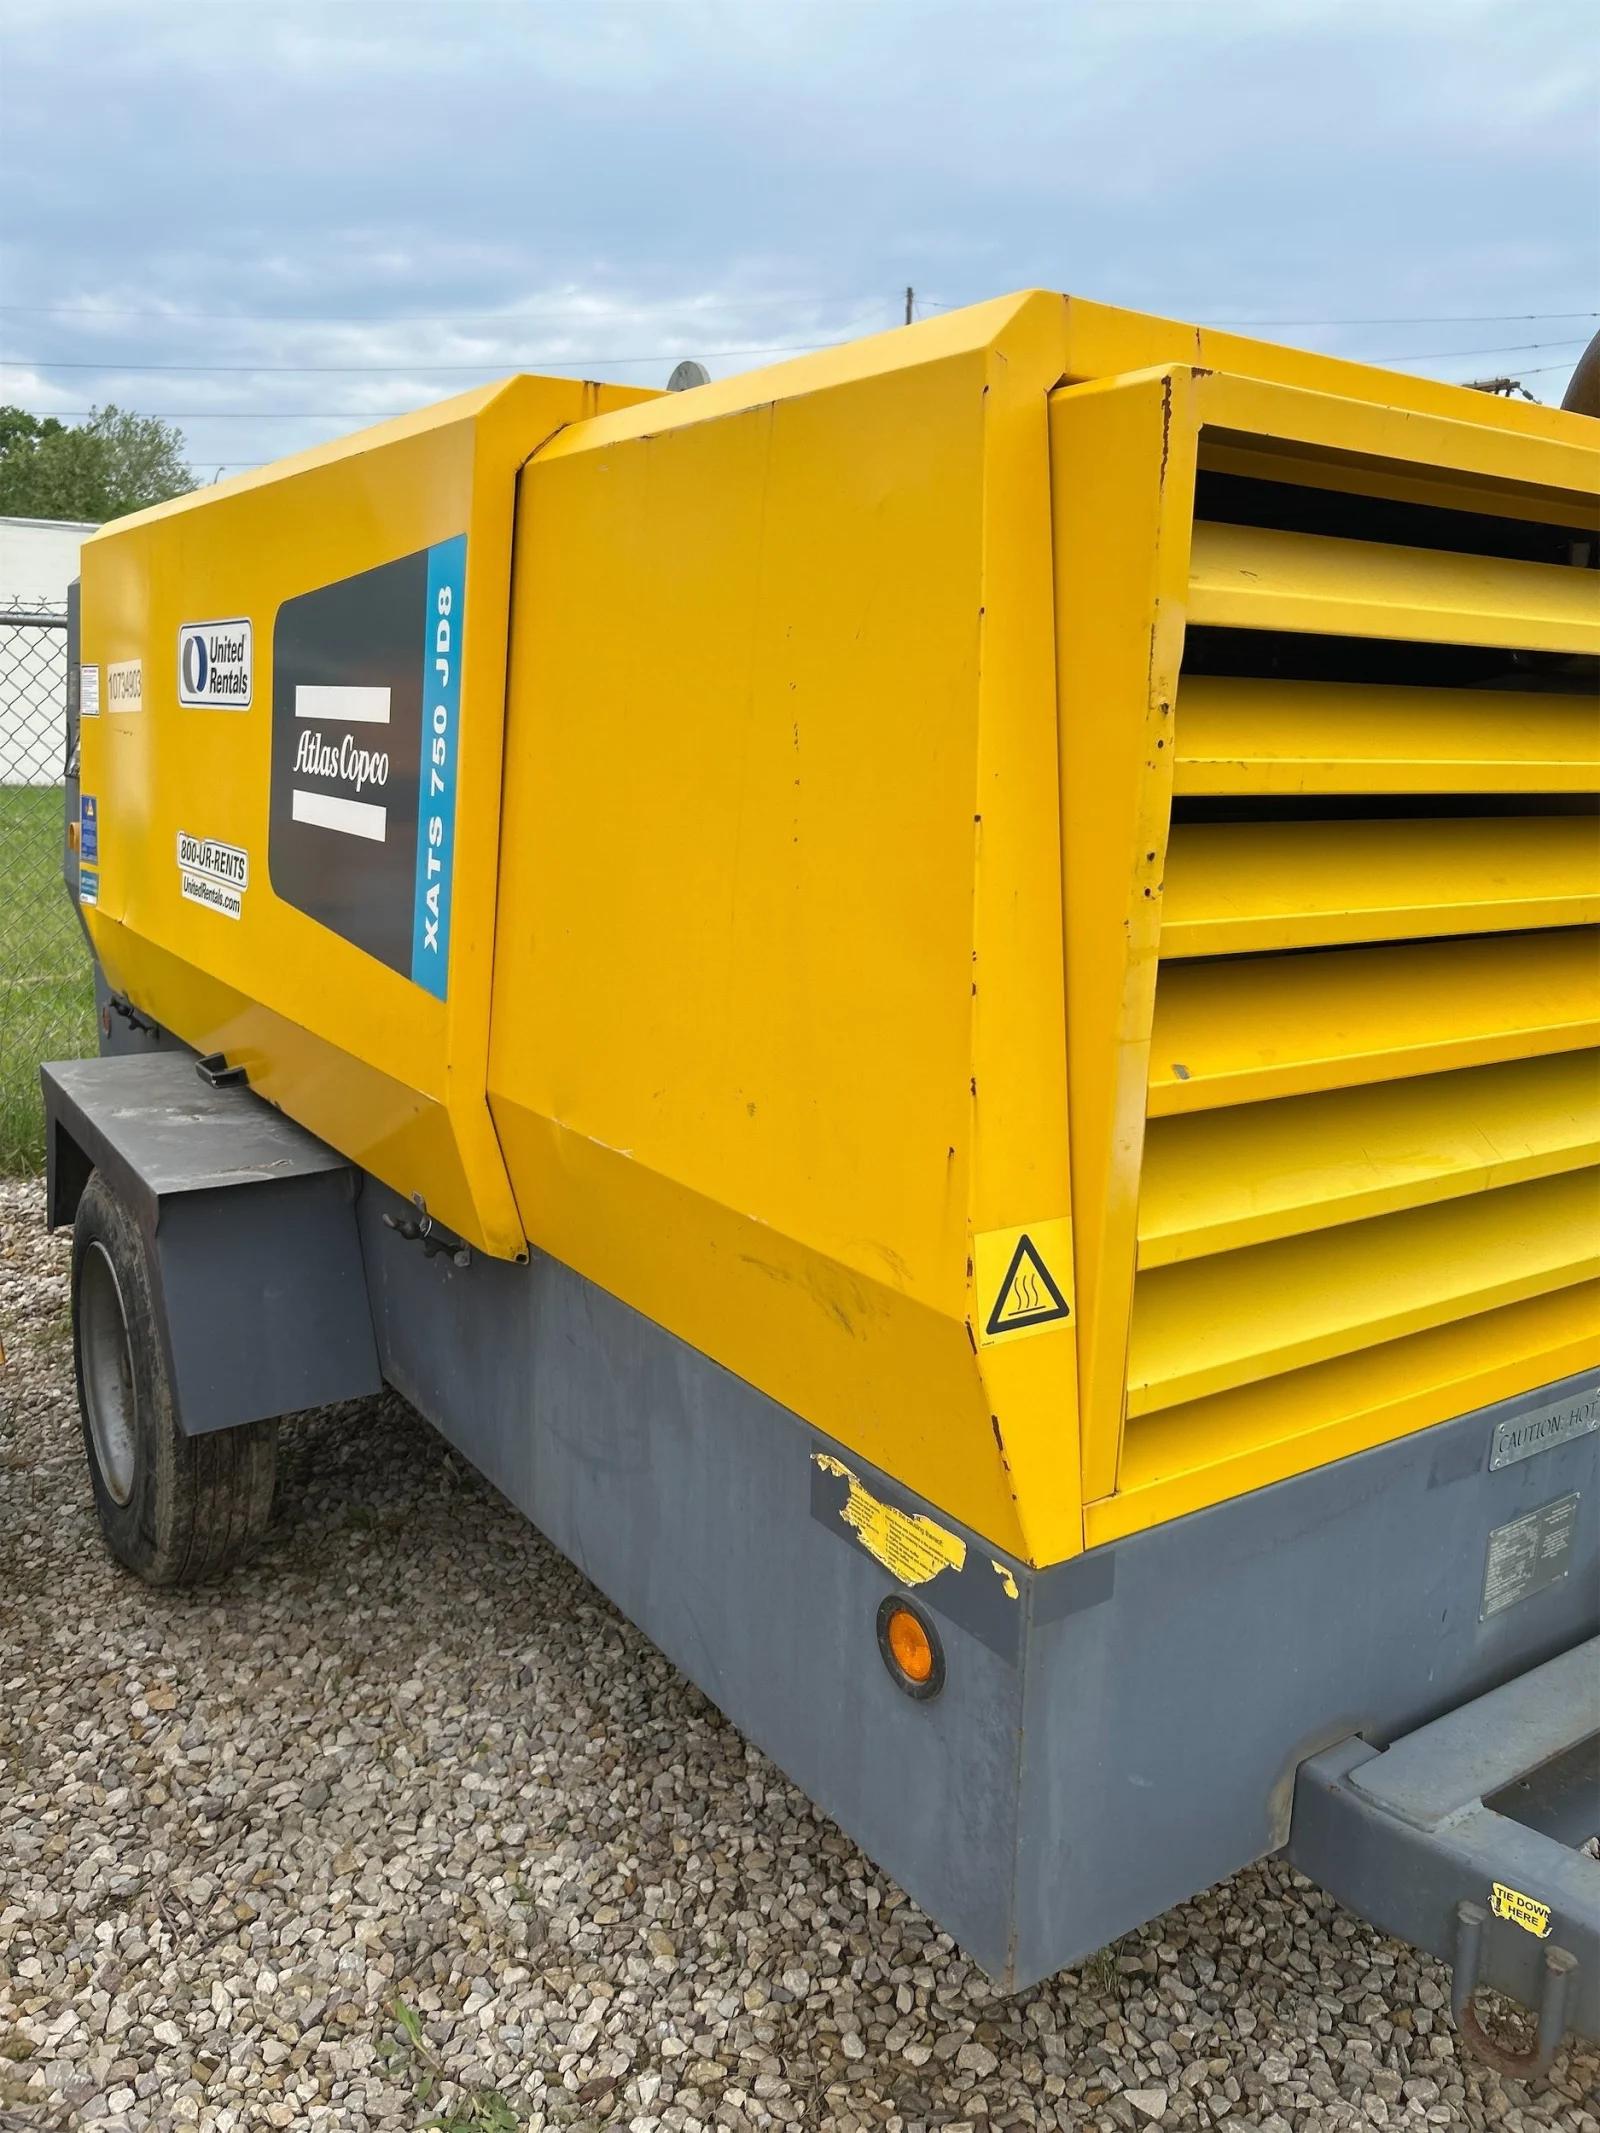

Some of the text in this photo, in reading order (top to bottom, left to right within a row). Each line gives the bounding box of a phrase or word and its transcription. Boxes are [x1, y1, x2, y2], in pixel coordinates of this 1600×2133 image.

[209, 634, 245, 663] United
[209, 666, 248, 694] Rentals
[293, 730, 389, 792] Atlas Copco
[424, 586, 452, 954] XATS 750 JD8
[181, 840, 245, 880] 800-UR-RENTS
[183, 876, 240, 913] UnitedRentals.com
[1499, 1401, 1599, 1453] CAUTION: HOT
[1497, 1888, 1514, 1902] TIE
[1508, 1905, 1539, 1927] HERE
